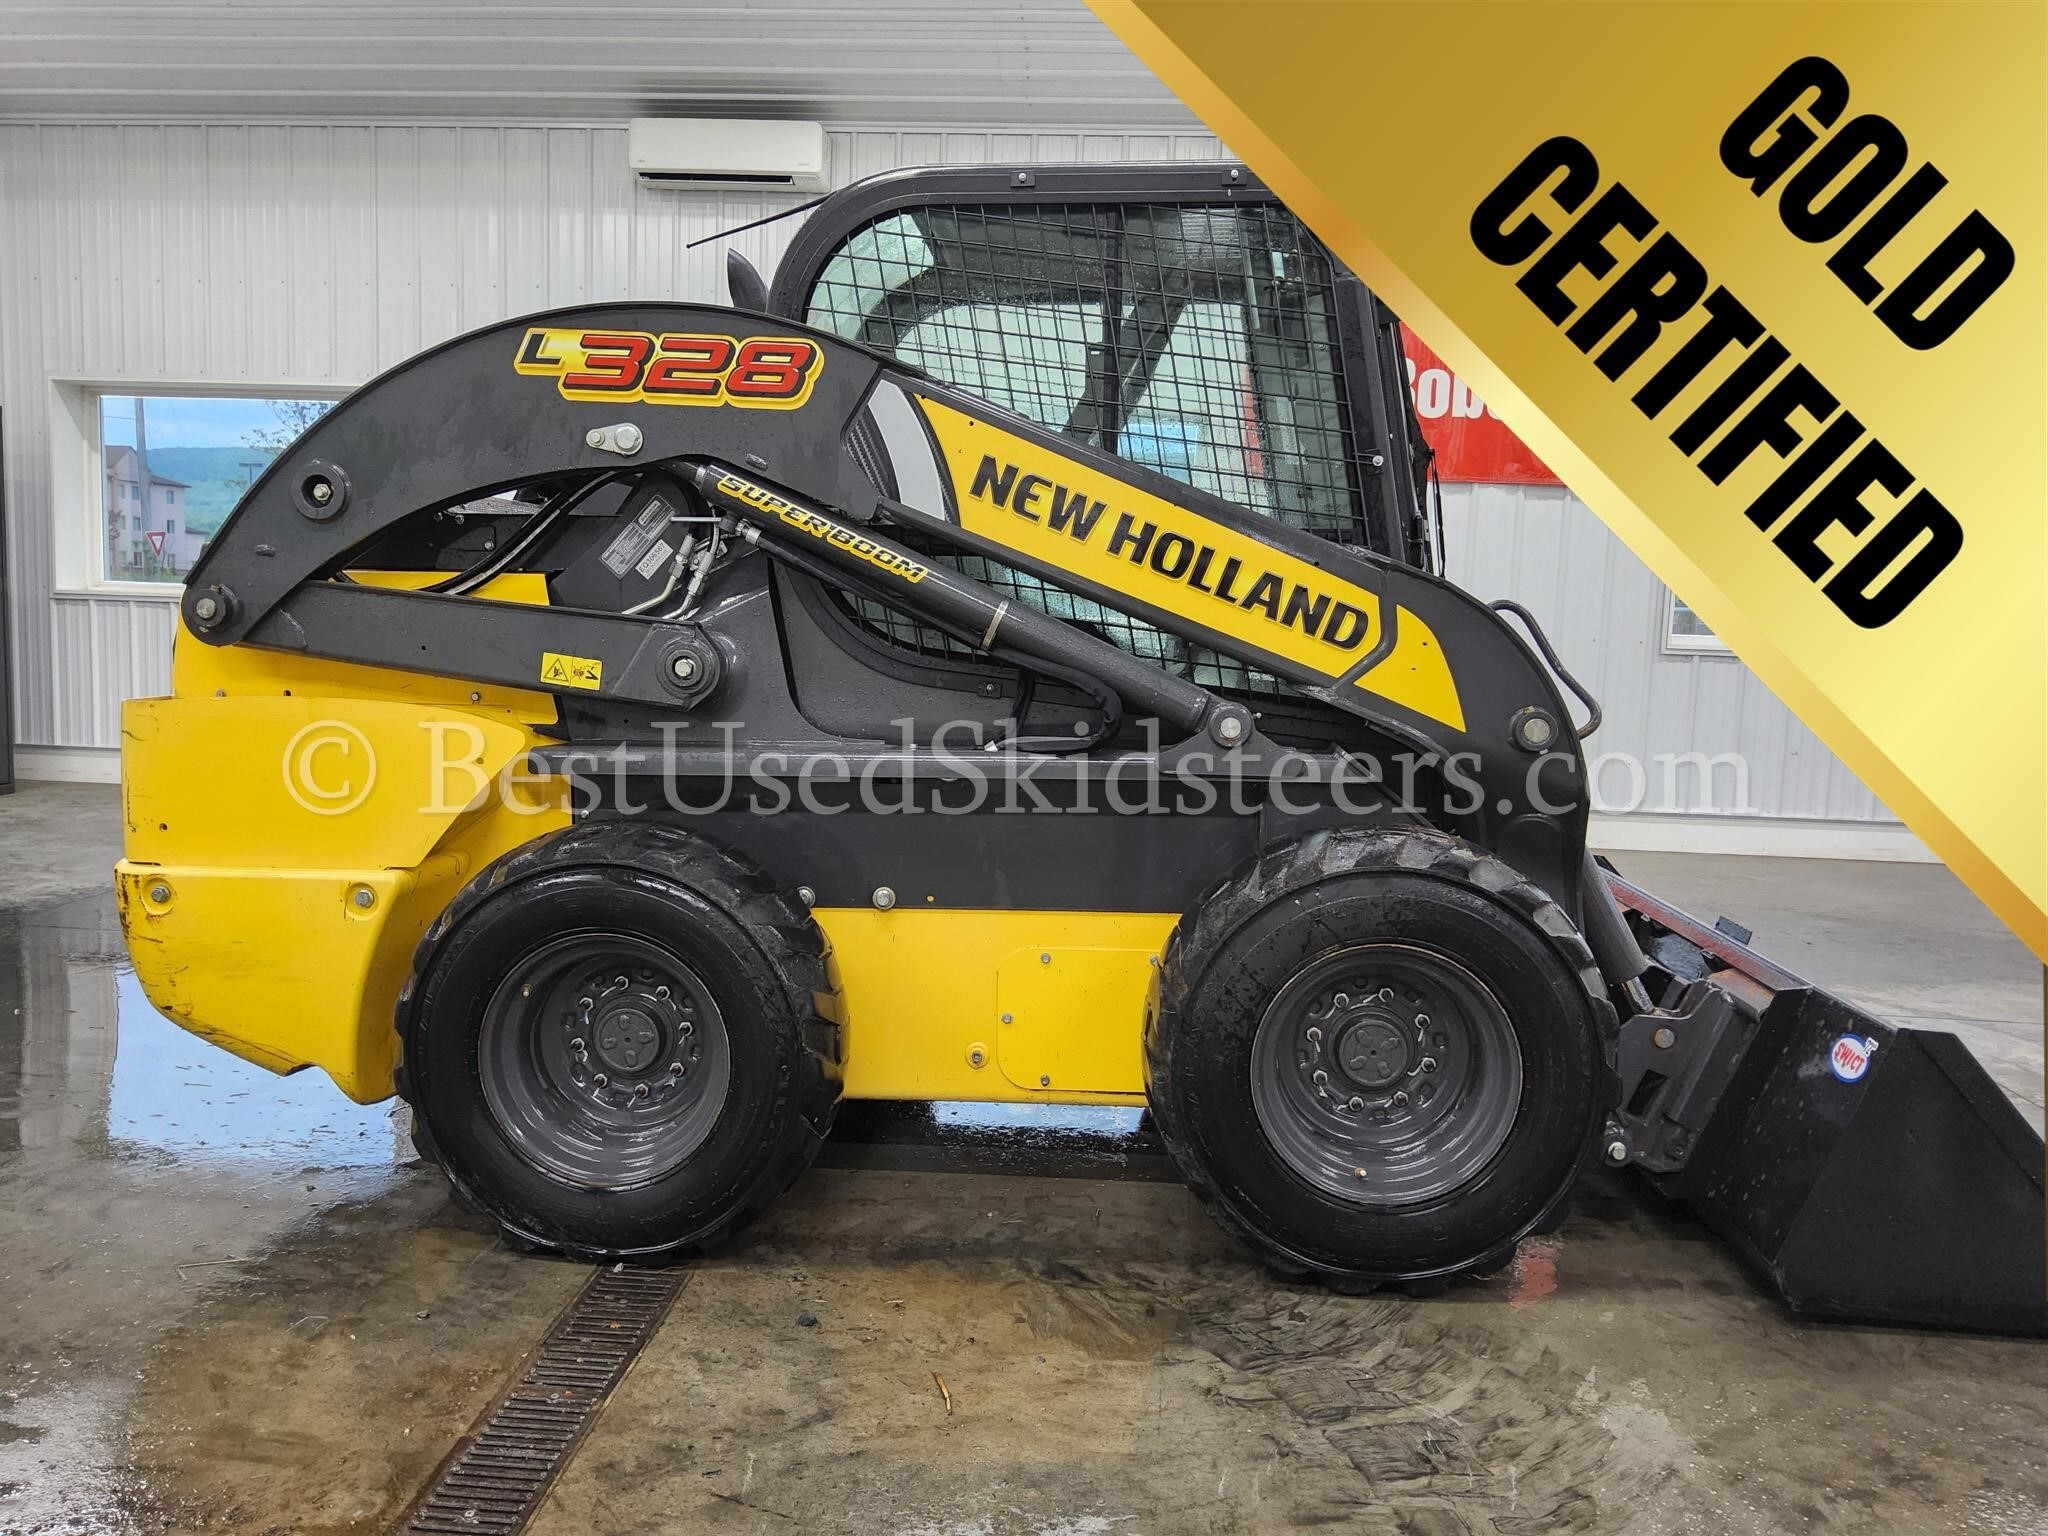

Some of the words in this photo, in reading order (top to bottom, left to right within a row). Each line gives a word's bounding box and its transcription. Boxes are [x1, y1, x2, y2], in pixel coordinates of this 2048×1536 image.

[969, 455, 1106, 542] NEW
[1106, 511, 1370, 650] HOLLAND
[1834, 1042, 1865, 1073] SWICT
